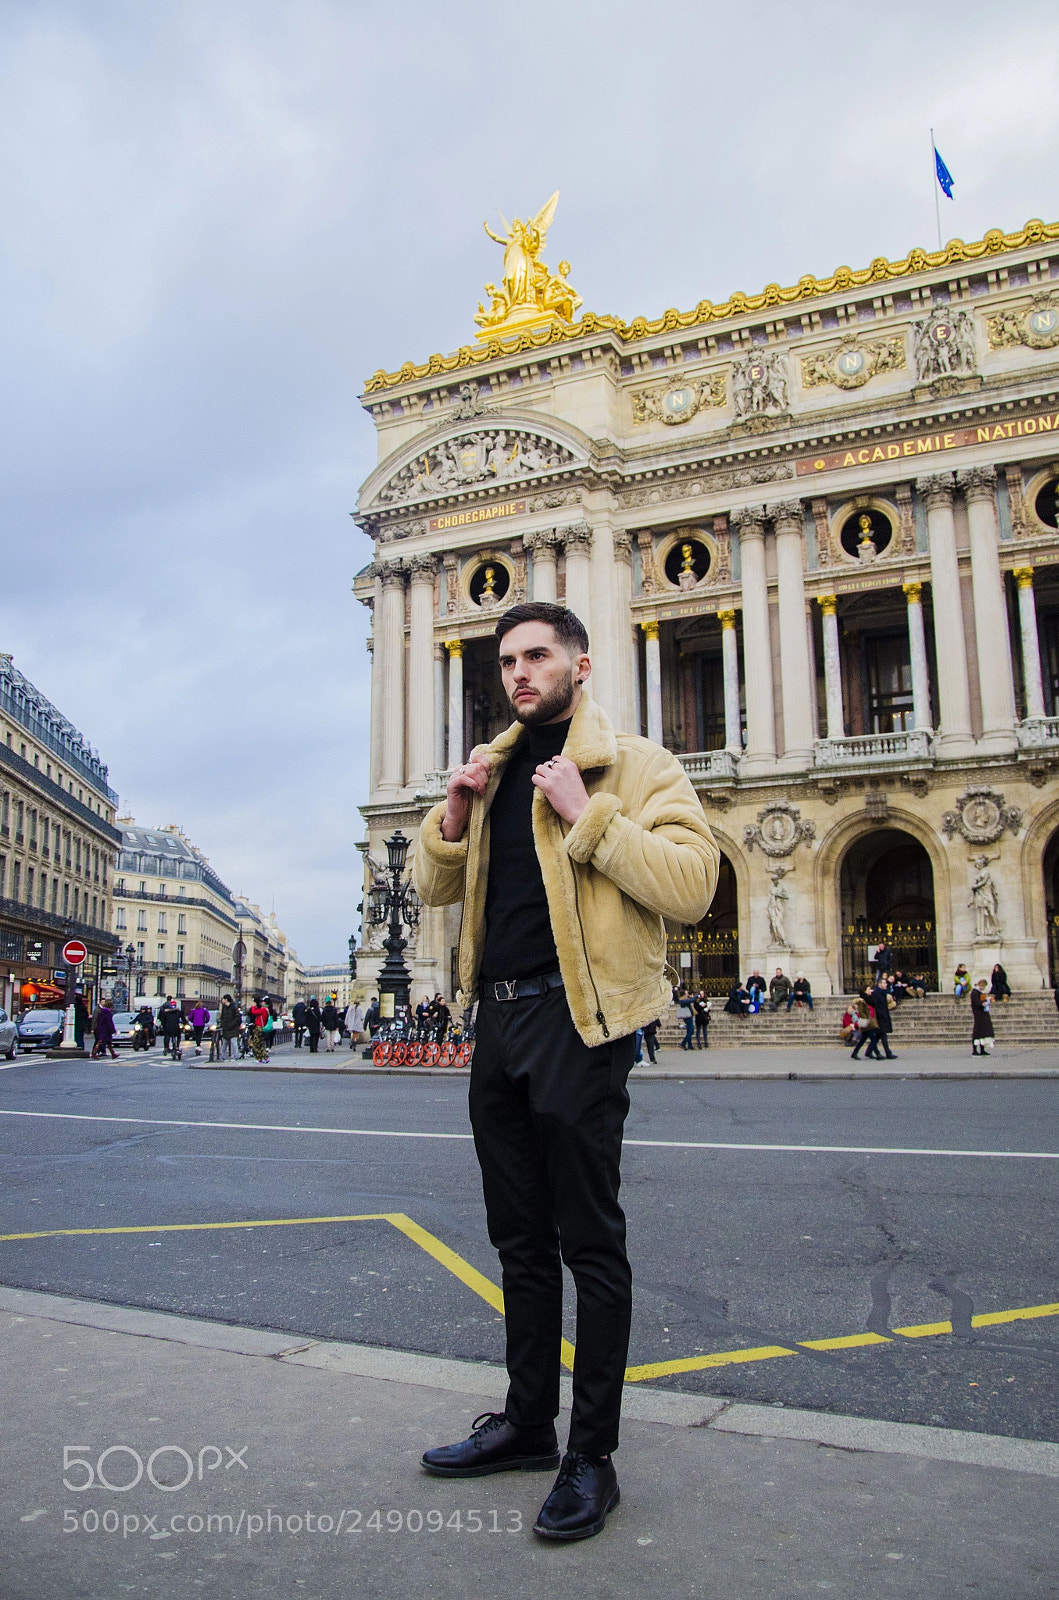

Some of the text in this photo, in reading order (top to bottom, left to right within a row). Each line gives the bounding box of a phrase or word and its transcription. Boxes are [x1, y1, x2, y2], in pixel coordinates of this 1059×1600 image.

[1037, 313, 1051, 329] N
[935, 326, 947, 339] E
[845, 354, 858, 369] N
[751, 367, 761, 380] E
[672, 393, 684, 407] N
[843, 433, 956, 467] ACADEMIE
[437, 503, 517, 529] CHOREGRAPHIE
